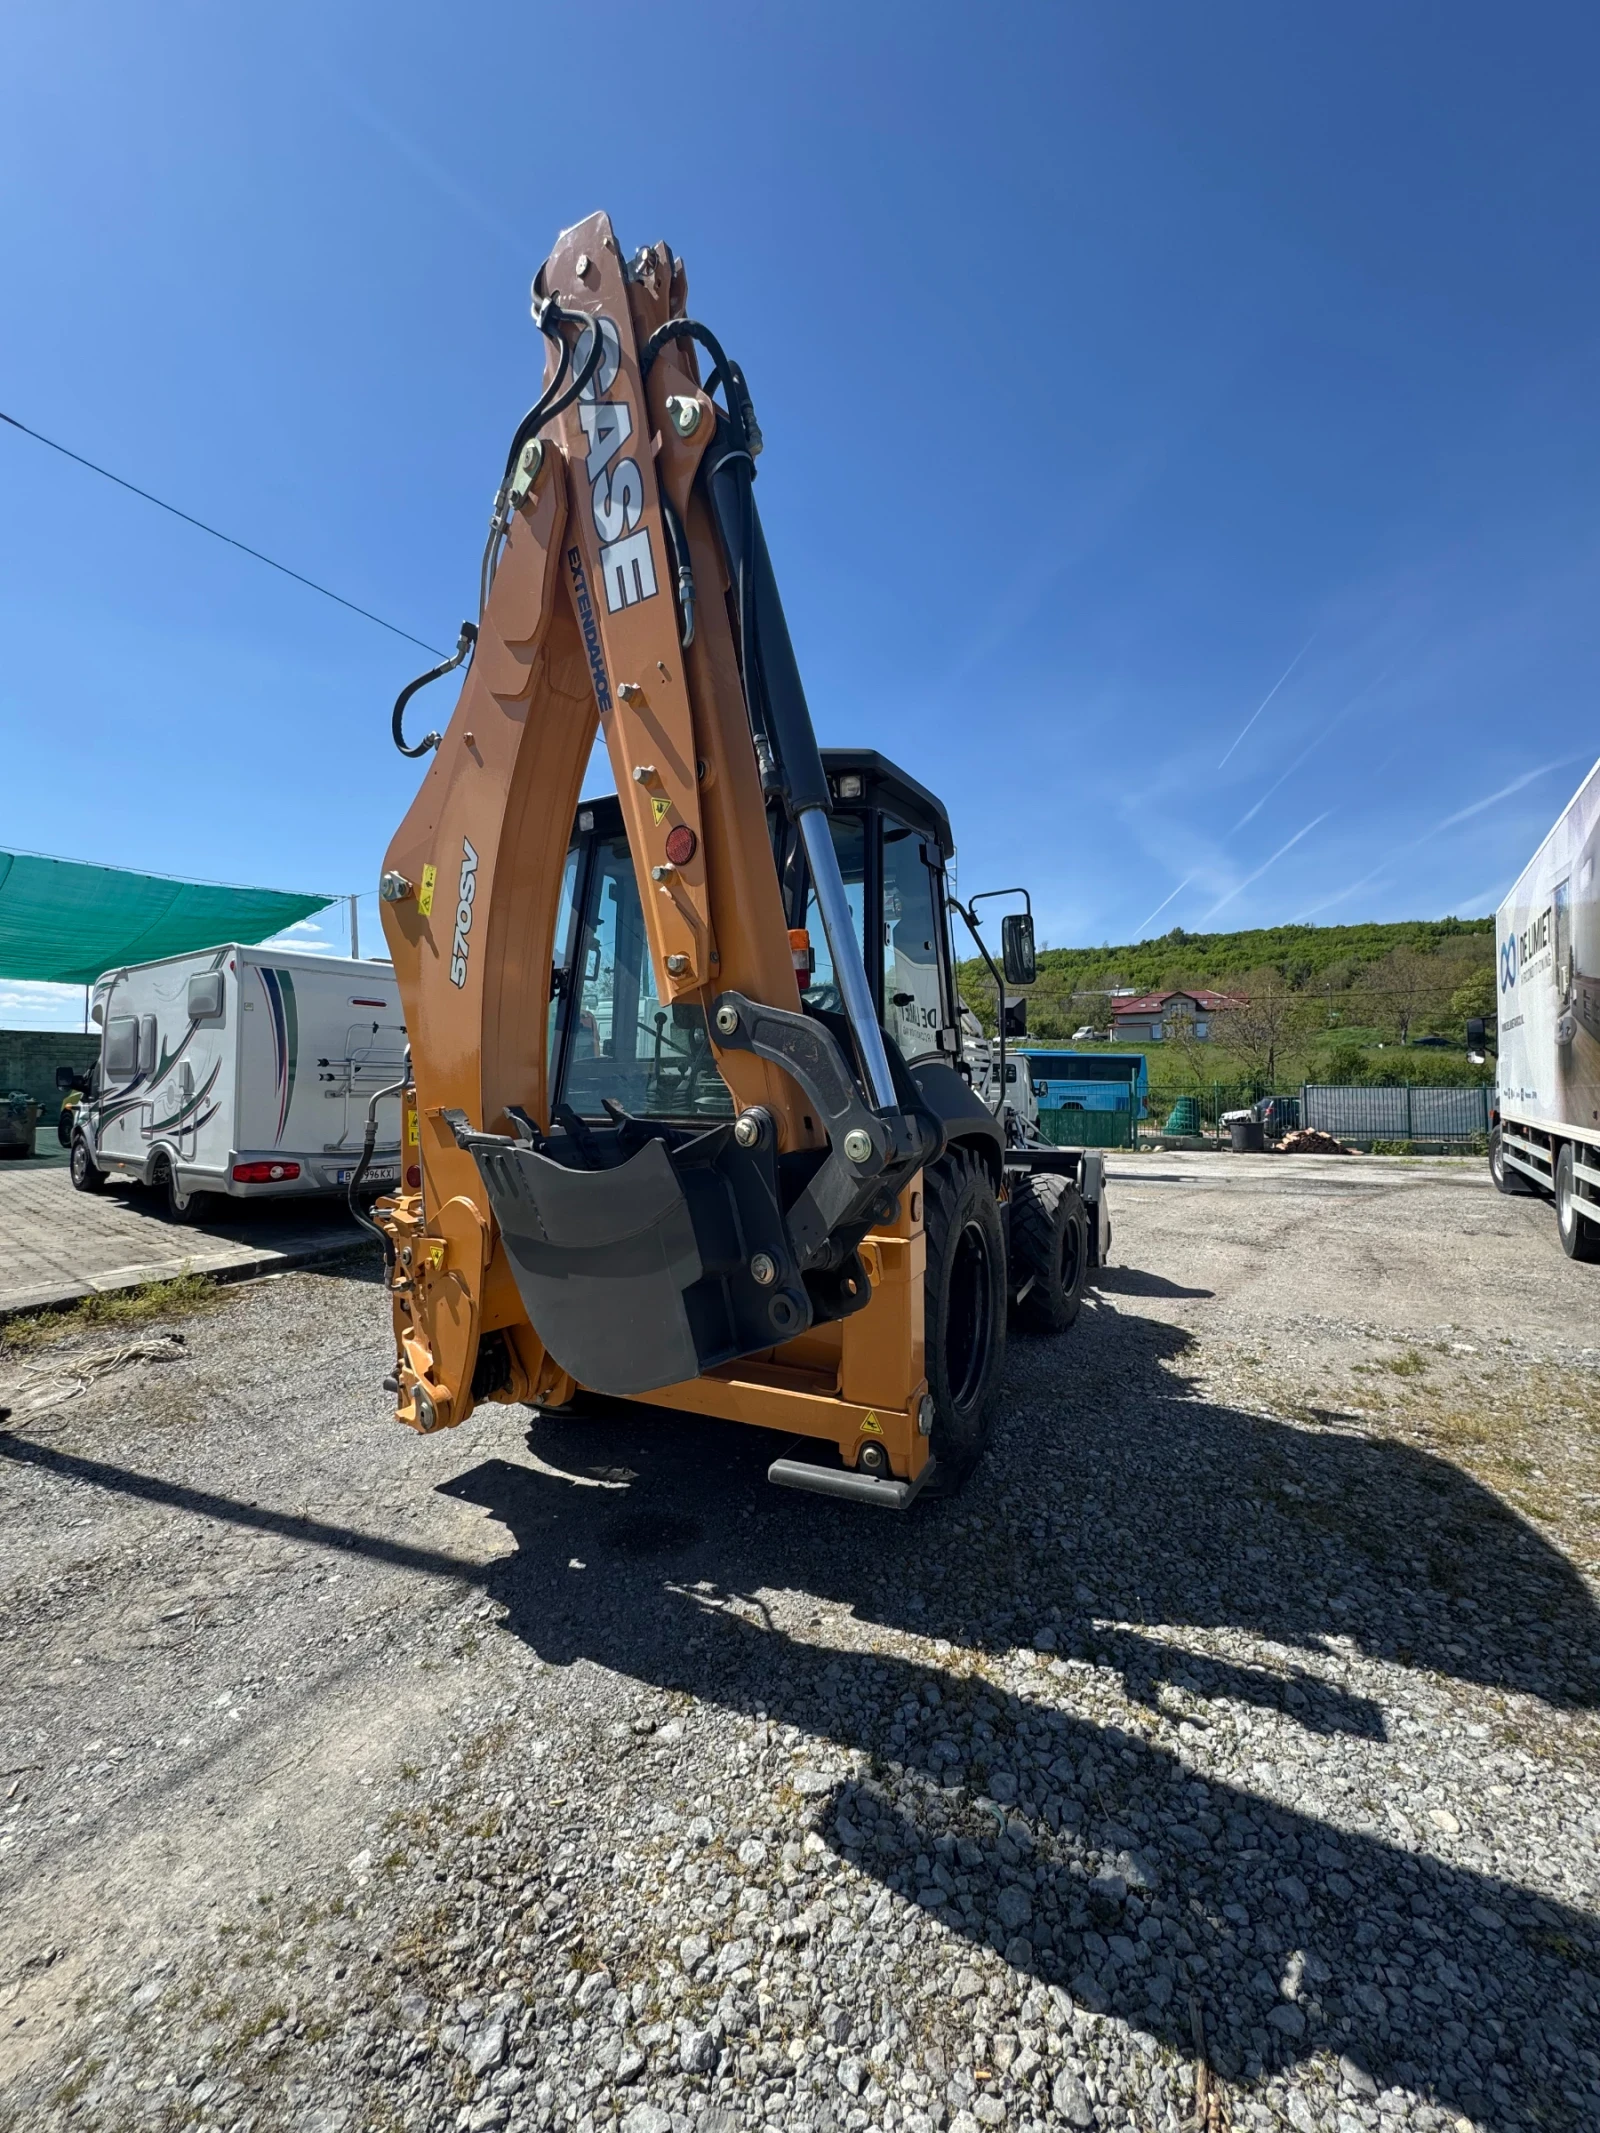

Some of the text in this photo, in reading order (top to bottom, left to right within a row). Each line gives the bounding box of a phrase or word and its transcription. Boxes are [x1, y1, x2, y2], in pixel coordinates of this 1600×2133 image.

[571, 315, 660, 616] CASE
[567, 545, 613, 714] EXTENDAHOE
[449, 835, 479, 990] 570SV
[380, 1169, 392, 1178] KX
